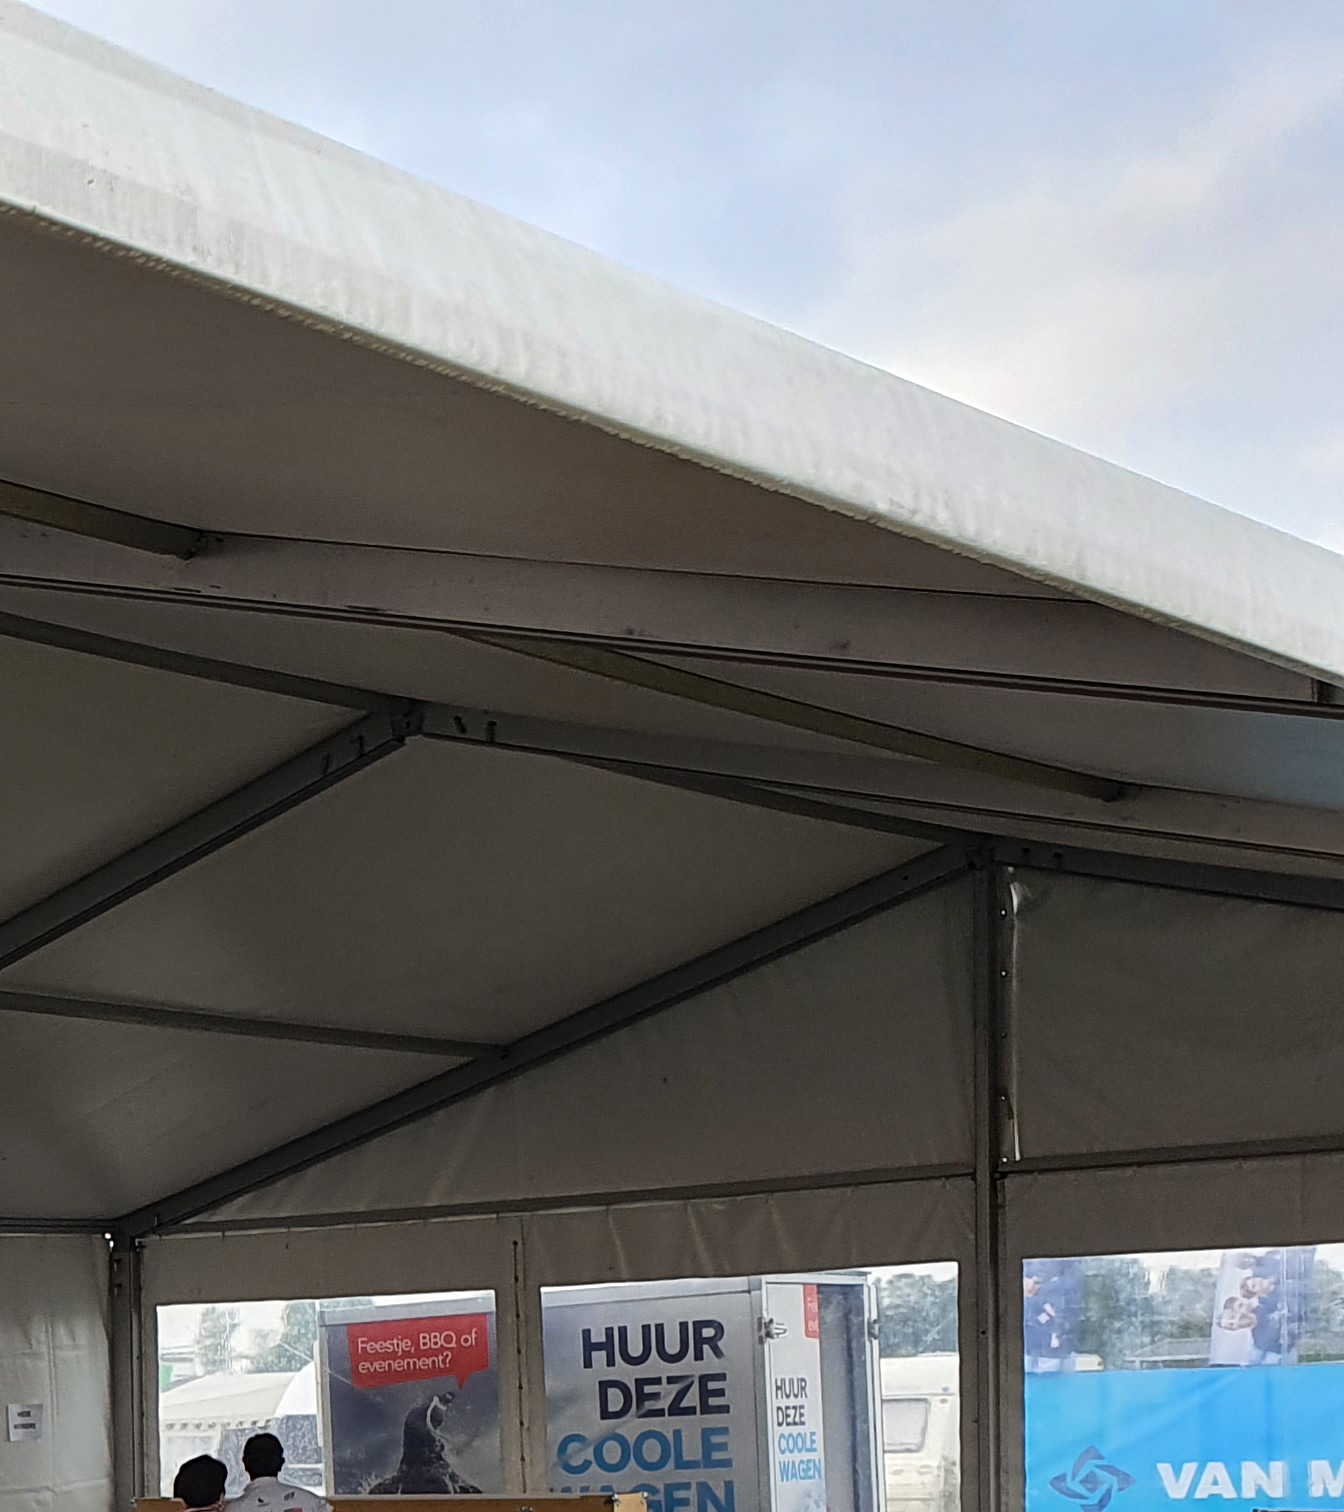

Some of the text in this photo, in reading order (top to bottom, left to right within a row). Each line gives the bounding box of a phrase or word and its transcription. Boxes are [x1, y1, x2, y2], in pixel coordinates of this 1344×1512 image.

[357, 1327, 477, 1356] Feestje, BBQ of
[581, 1319, 725, 1369] HUUR
[358, 1350, 452, 1373] evenement?
[597, 1372, 731, 1421] DEZE
[775, 1377, 808, 1400] HUUR
[776, 1404, 806, 1427] DEZE
[556, 1426, 733, 1475] COOLE
[778, 1431, 817, 1455] COOLE
[779, 1458, 823, 1482] WAGEN
[1155, 1460, 1285, 1500] VAN
